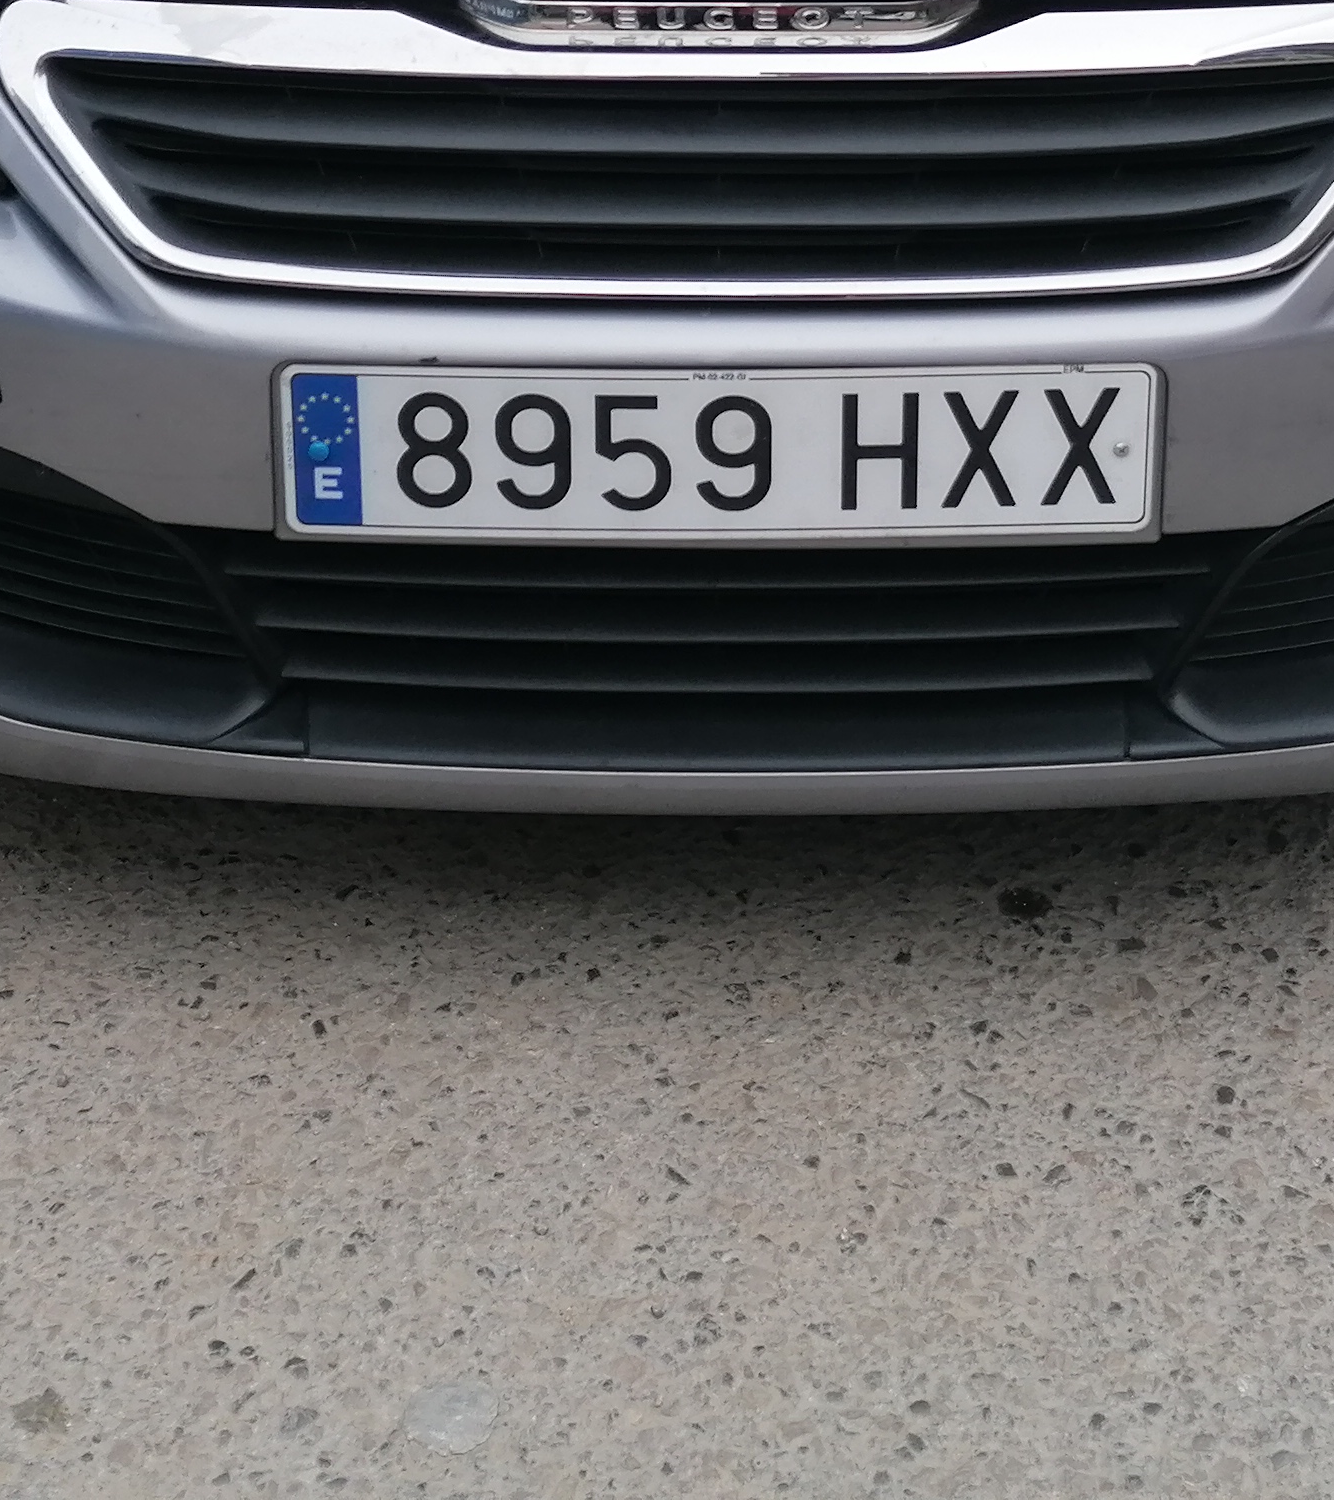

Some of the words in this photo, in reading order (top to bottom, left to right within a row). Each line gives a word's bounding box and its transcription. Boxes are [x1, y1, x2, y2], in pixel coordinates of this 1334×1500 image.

[566, 5, 879, 31] PEUGEOT
[313, 466, 344, 500] E
[395, 390, 772, 513] 8959
[839, 386, 1122, 512] HXX
